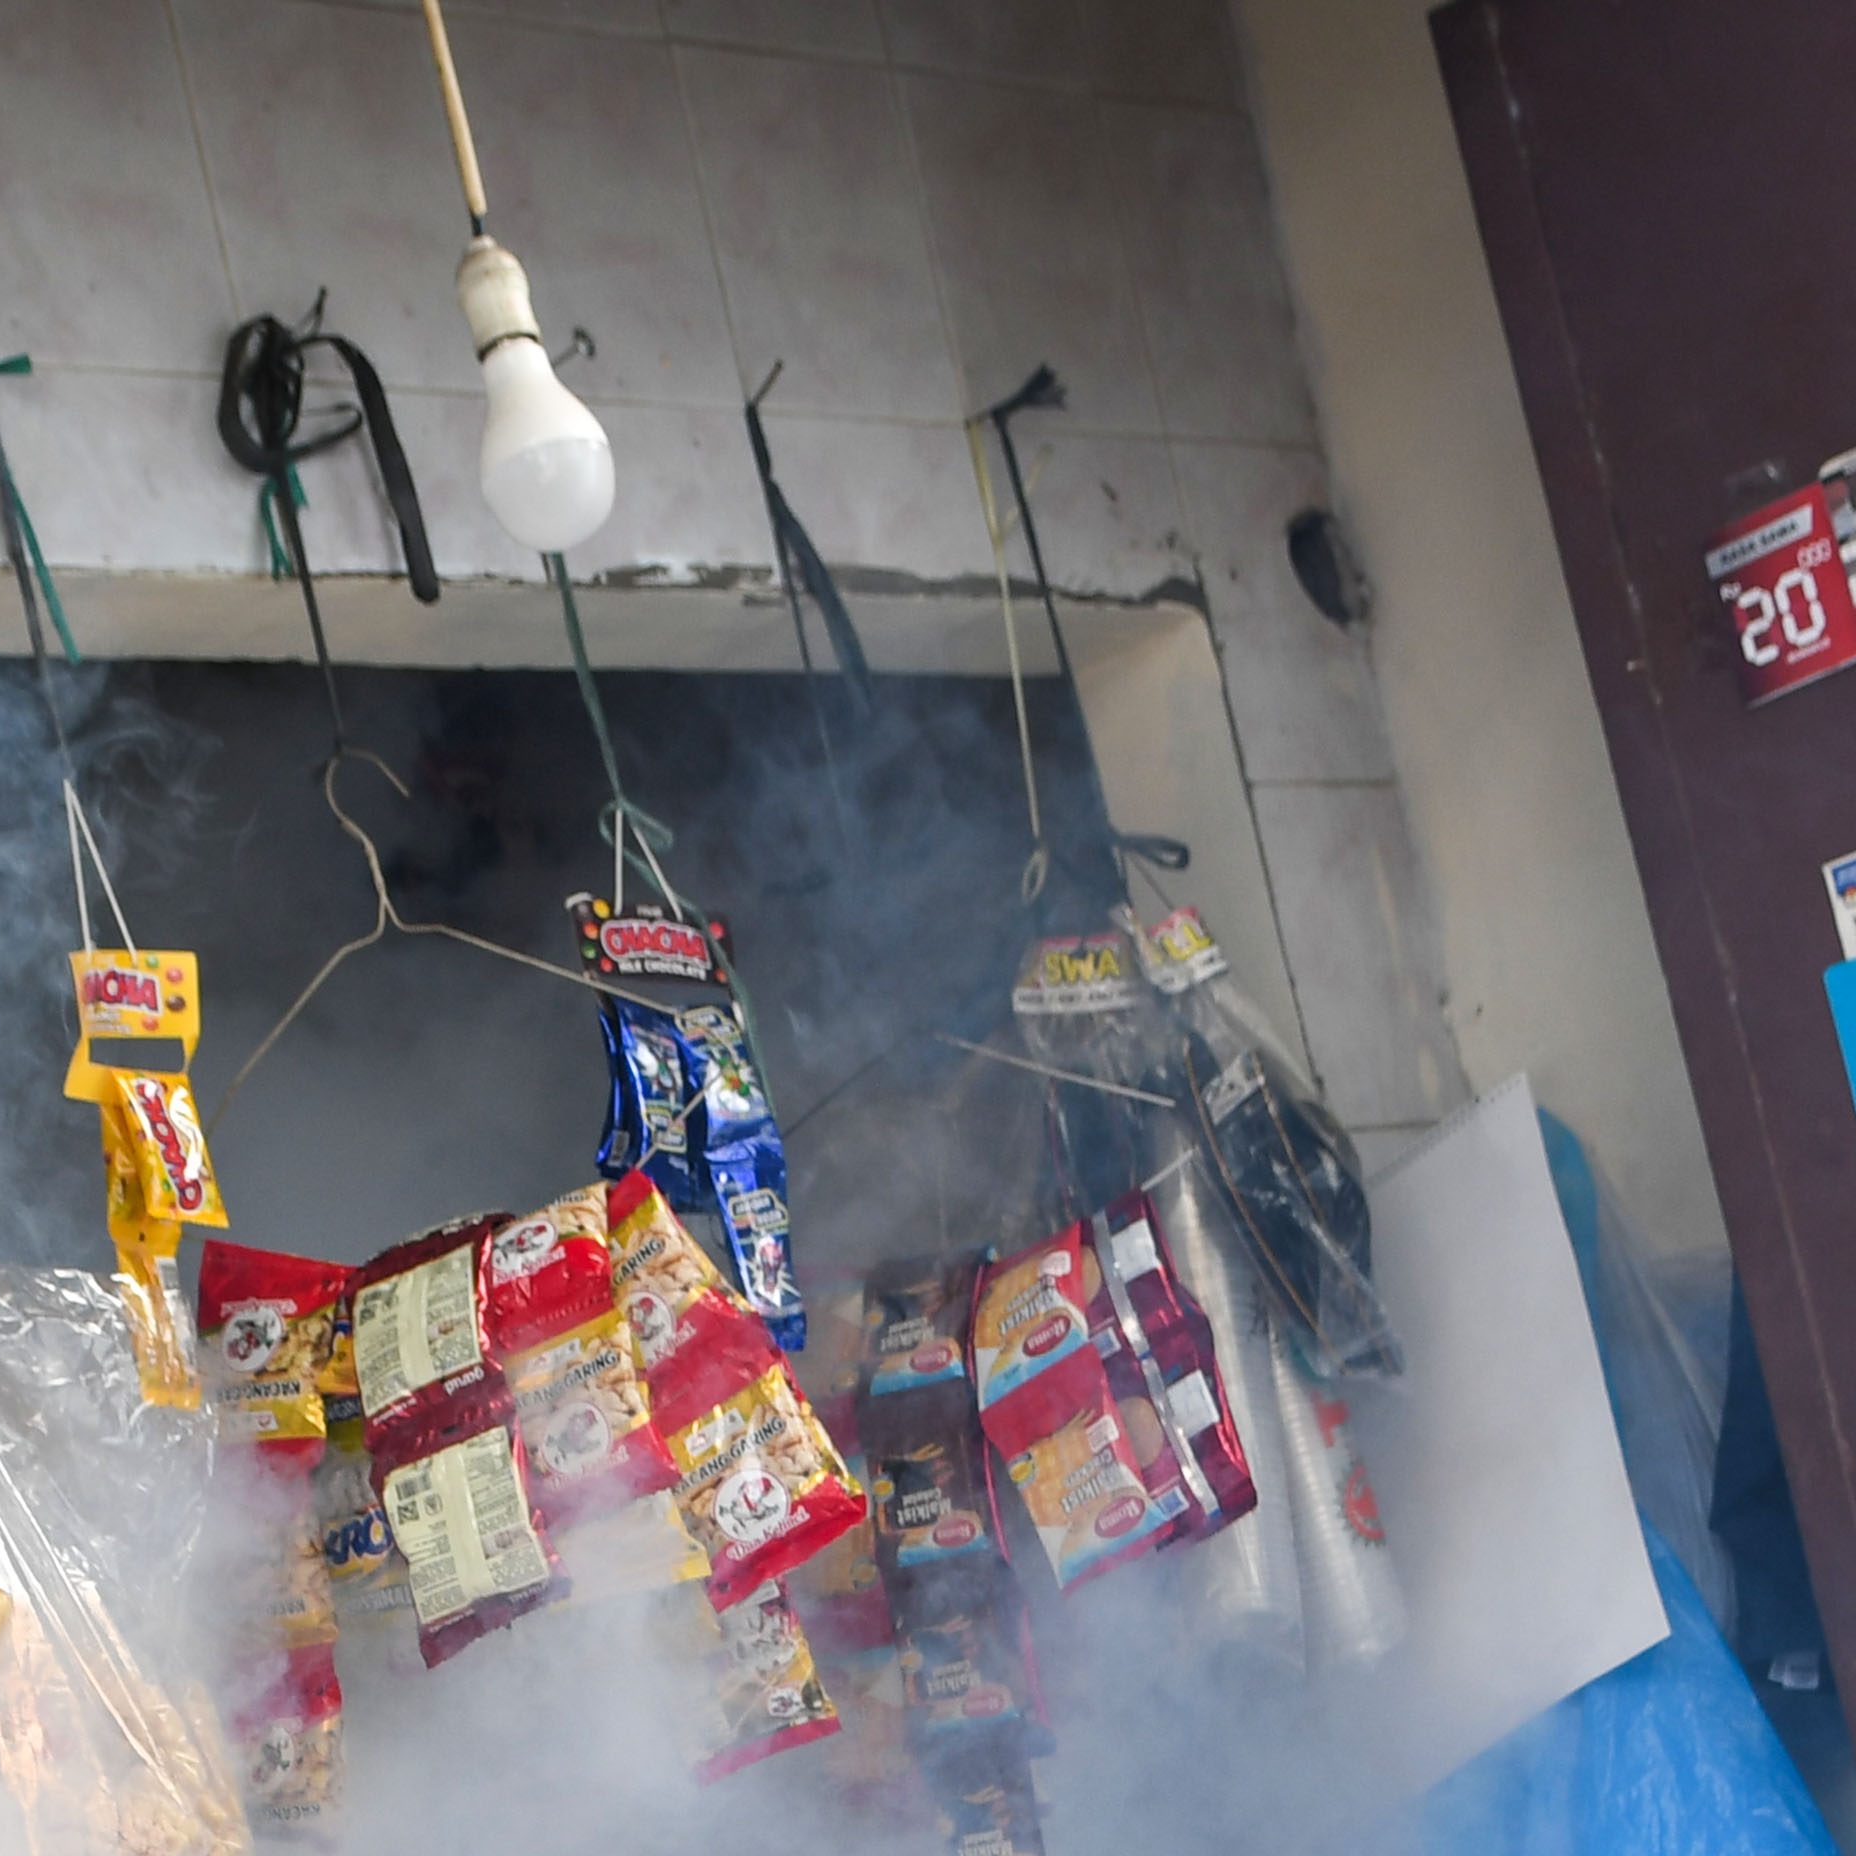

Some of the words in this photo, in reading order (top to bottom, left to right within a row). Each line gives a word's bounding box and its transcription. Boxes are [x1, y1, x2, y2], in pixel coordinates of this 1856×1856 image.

[1737, 568, 1827, 667] 20
[613, 1238, 664, 1287] GARING
[670, 1454, 730, 1497] KACANG
